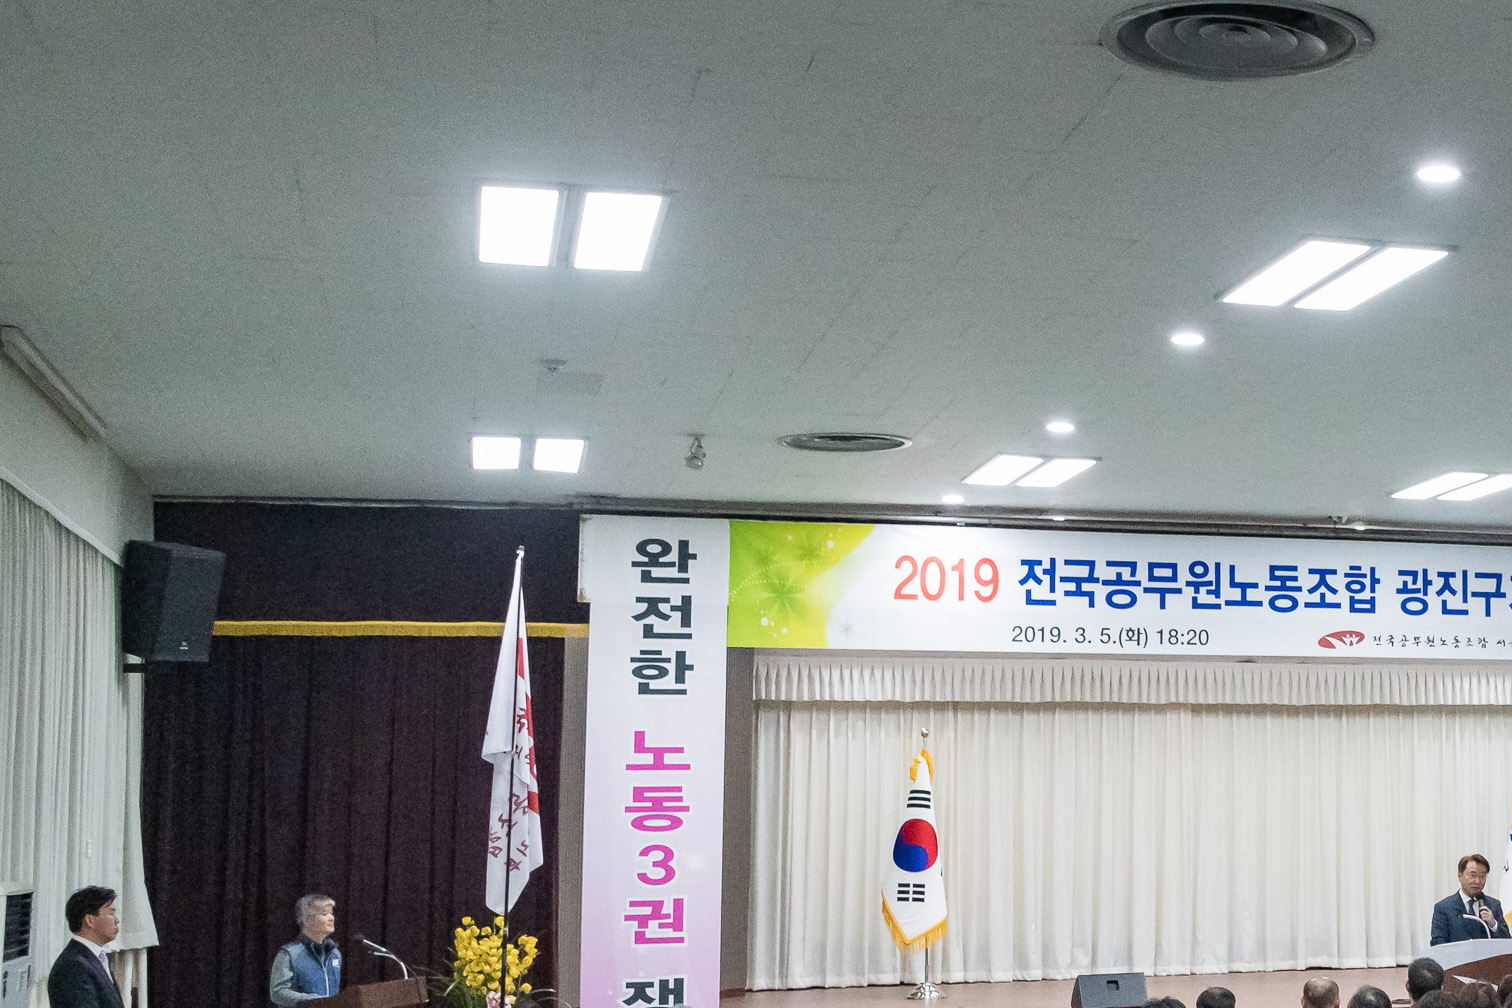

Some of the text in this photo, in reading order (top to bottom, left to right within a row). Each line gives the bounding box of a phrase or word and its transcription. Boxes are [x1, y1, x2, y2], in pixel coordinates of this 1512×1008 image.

[894, 555, 1000, 602] 2019
[1018, 557, 1380, 614] 전국공무원노동조합
[630, 538, 697, 695] 완전한
[1012, 626, 1068, 643] 2019.
[1074, 627, 1093, 644] 3.
[1156, 629, 1210, 646] 18:20
[1373, 634, 1488, 648] 전국공무원노동조합
[624, 731, 691, 945] 노동3권
